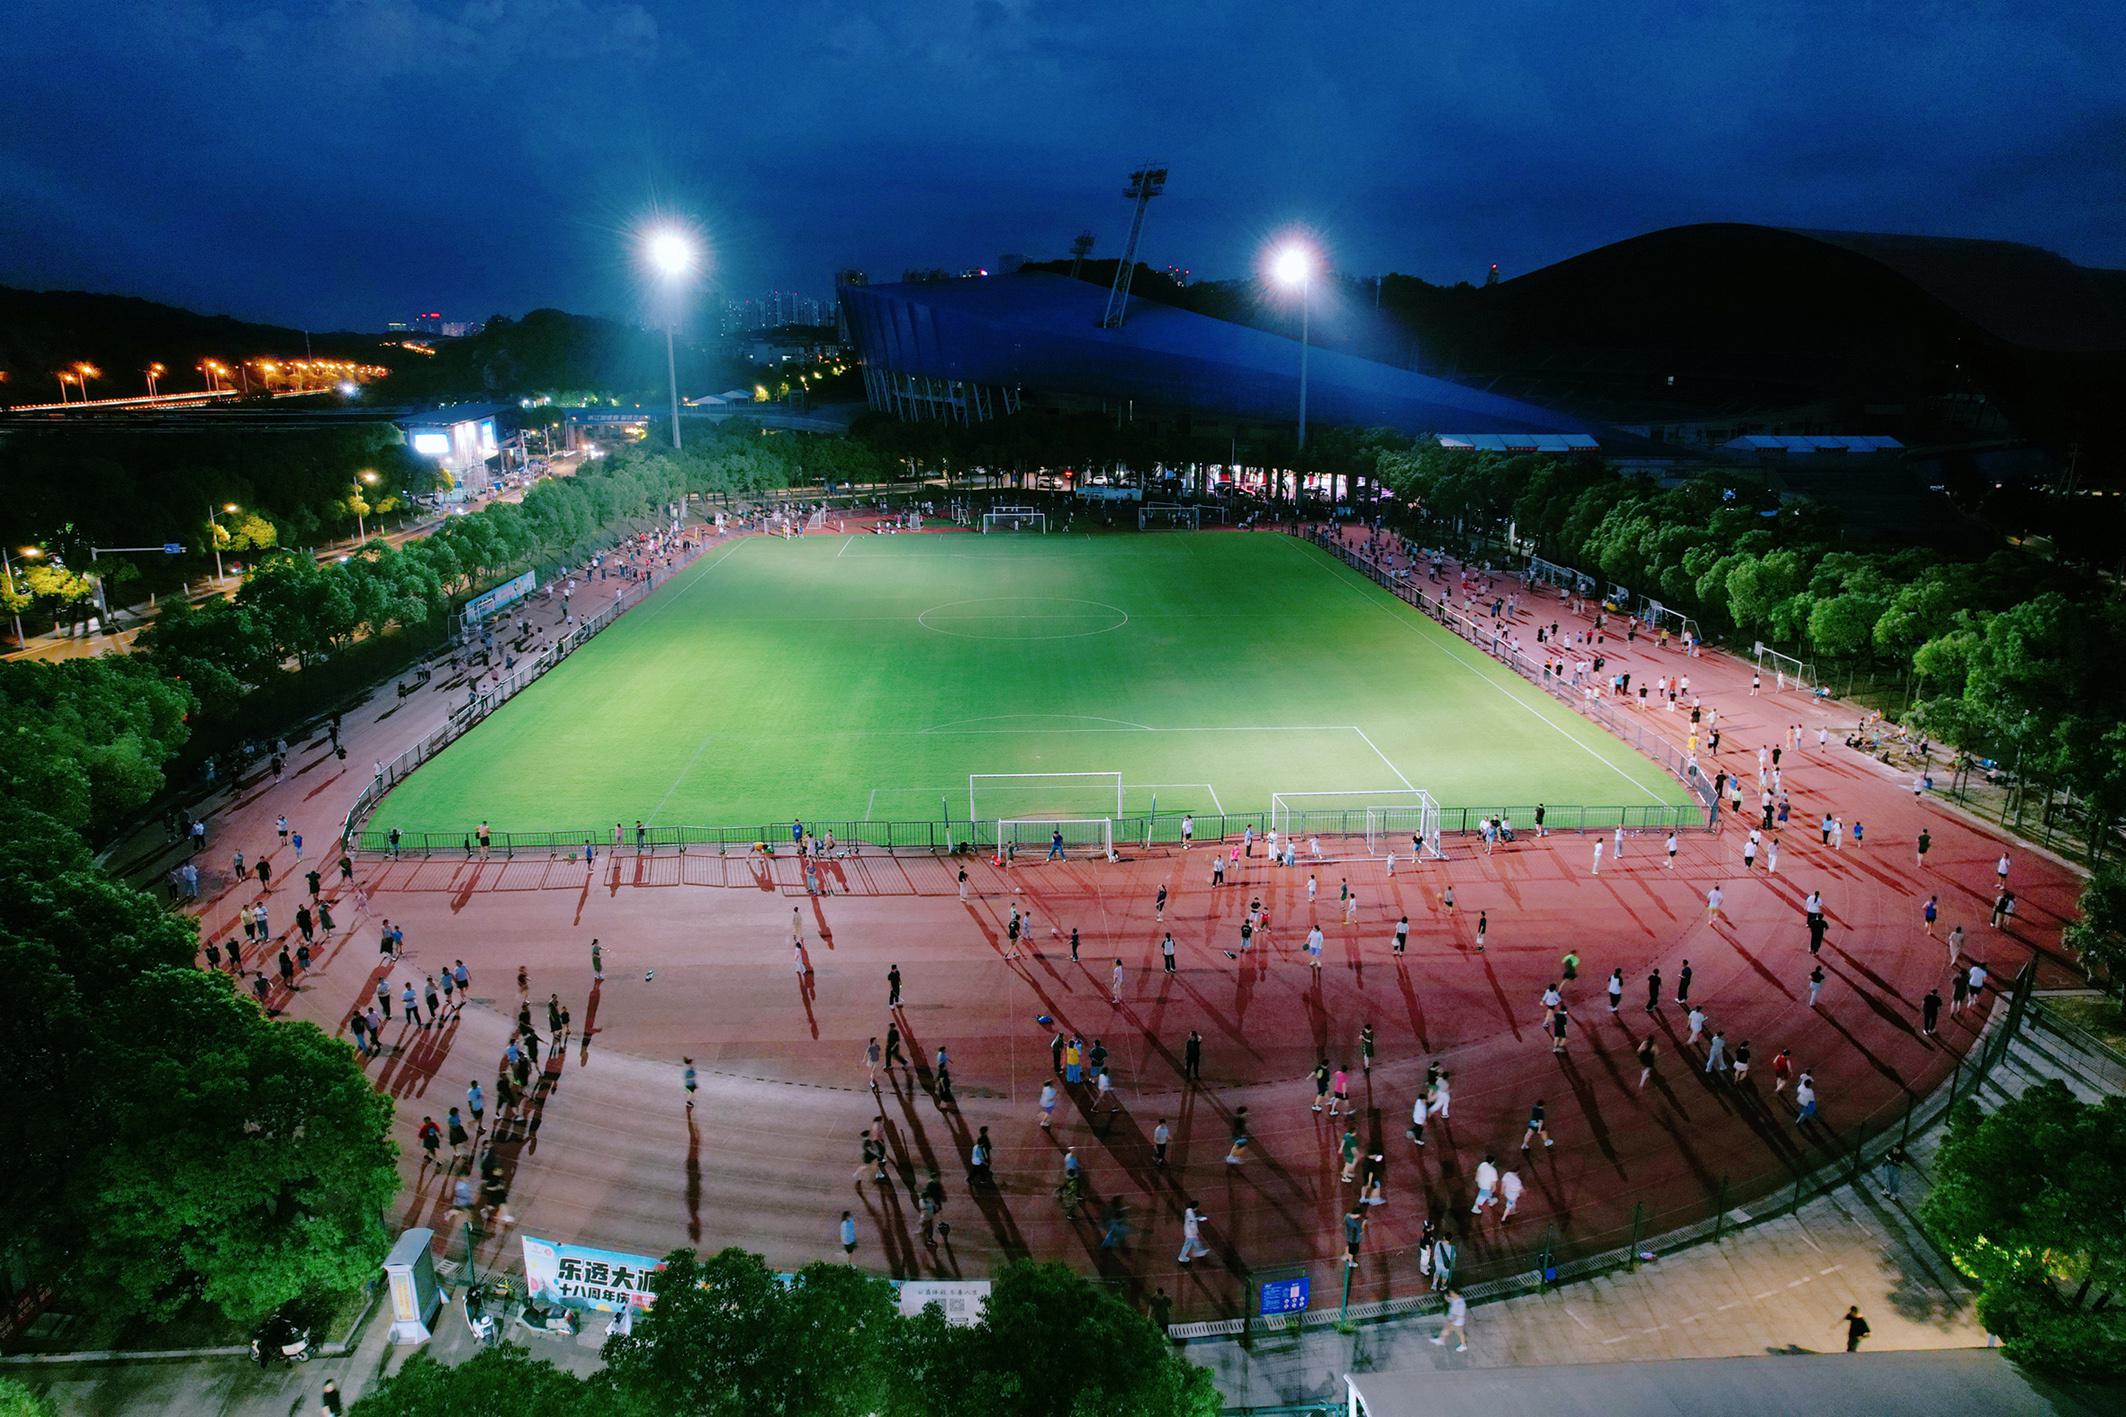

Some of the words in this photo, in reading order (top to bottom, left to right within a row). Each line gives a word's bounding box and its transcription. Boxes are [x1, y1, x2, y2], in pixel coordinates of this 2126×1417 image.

[558, 1283, 631, 1304] 十八周年庆
